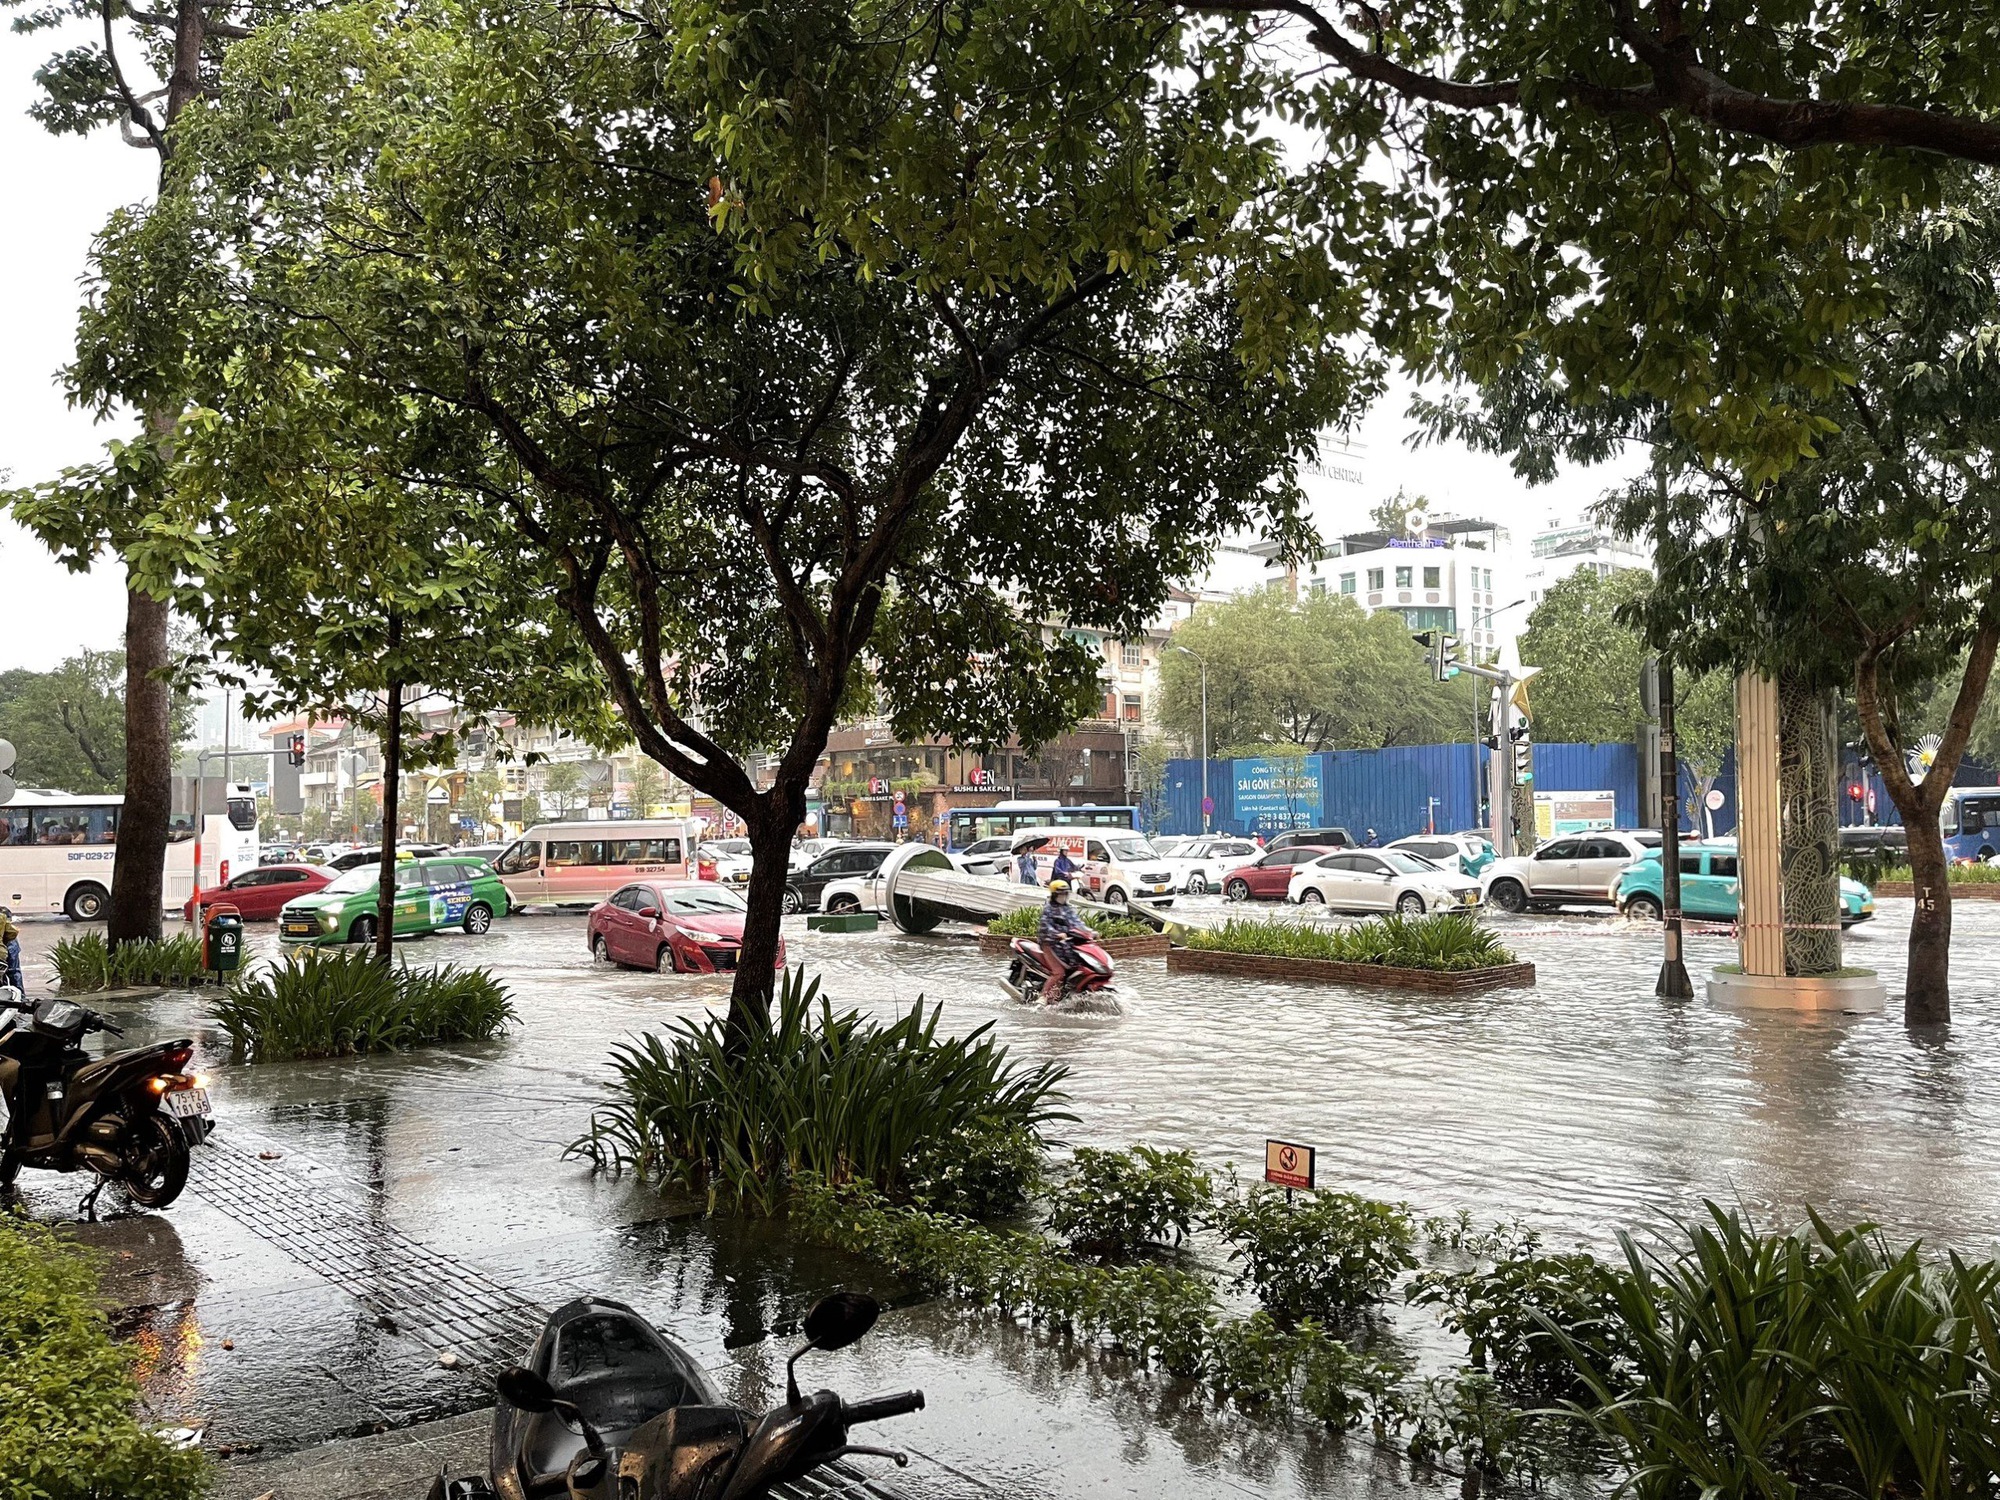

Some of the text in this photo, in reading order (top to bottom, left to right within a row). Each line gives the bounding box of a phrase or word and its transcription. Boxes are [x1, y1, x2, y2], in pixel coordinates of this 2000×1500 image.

[1238, 778, 1251, 791] SÀI
[1251, 777, 1270, 790] GÒN
[1922, 886, 1932, 898] T
[1917, 898, 1935, 911] 45
[175, 1091, 202, 1104] 75-F2
[176, 1101, 208, 1116] 181.95
